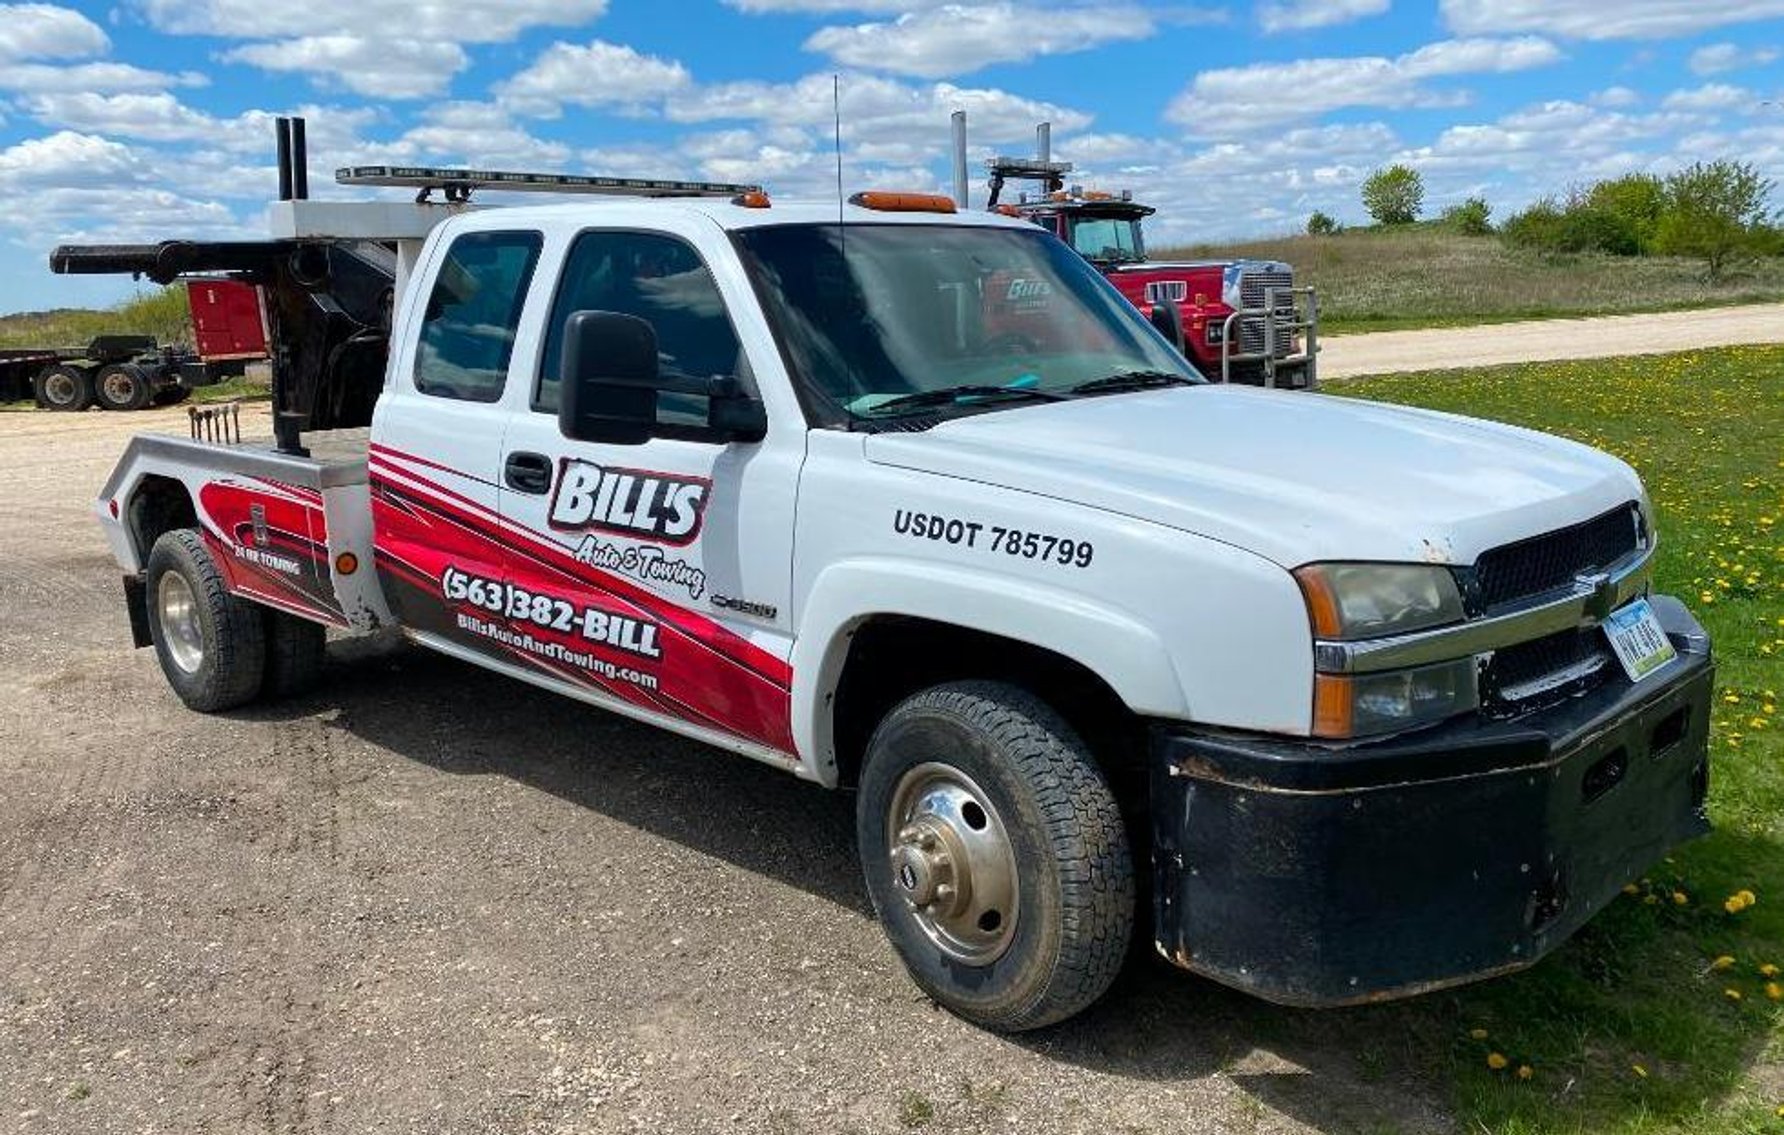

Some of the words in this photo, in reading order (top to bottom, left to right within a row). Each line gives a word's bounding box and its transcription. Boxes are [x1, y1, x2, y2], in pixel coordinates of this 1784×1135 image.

[552, 461, 704, 537] BILL'S
[260, 552, 300, 575] TOWING
[574, 535, 625, 570] Auto
[637, 546, 706, 599] Towing
[894, 510, 983, 548] USDOT
[991, 526, 1093, 568] 785799
[457, 613, 658, 690] BillsAutoAndTowing.com
